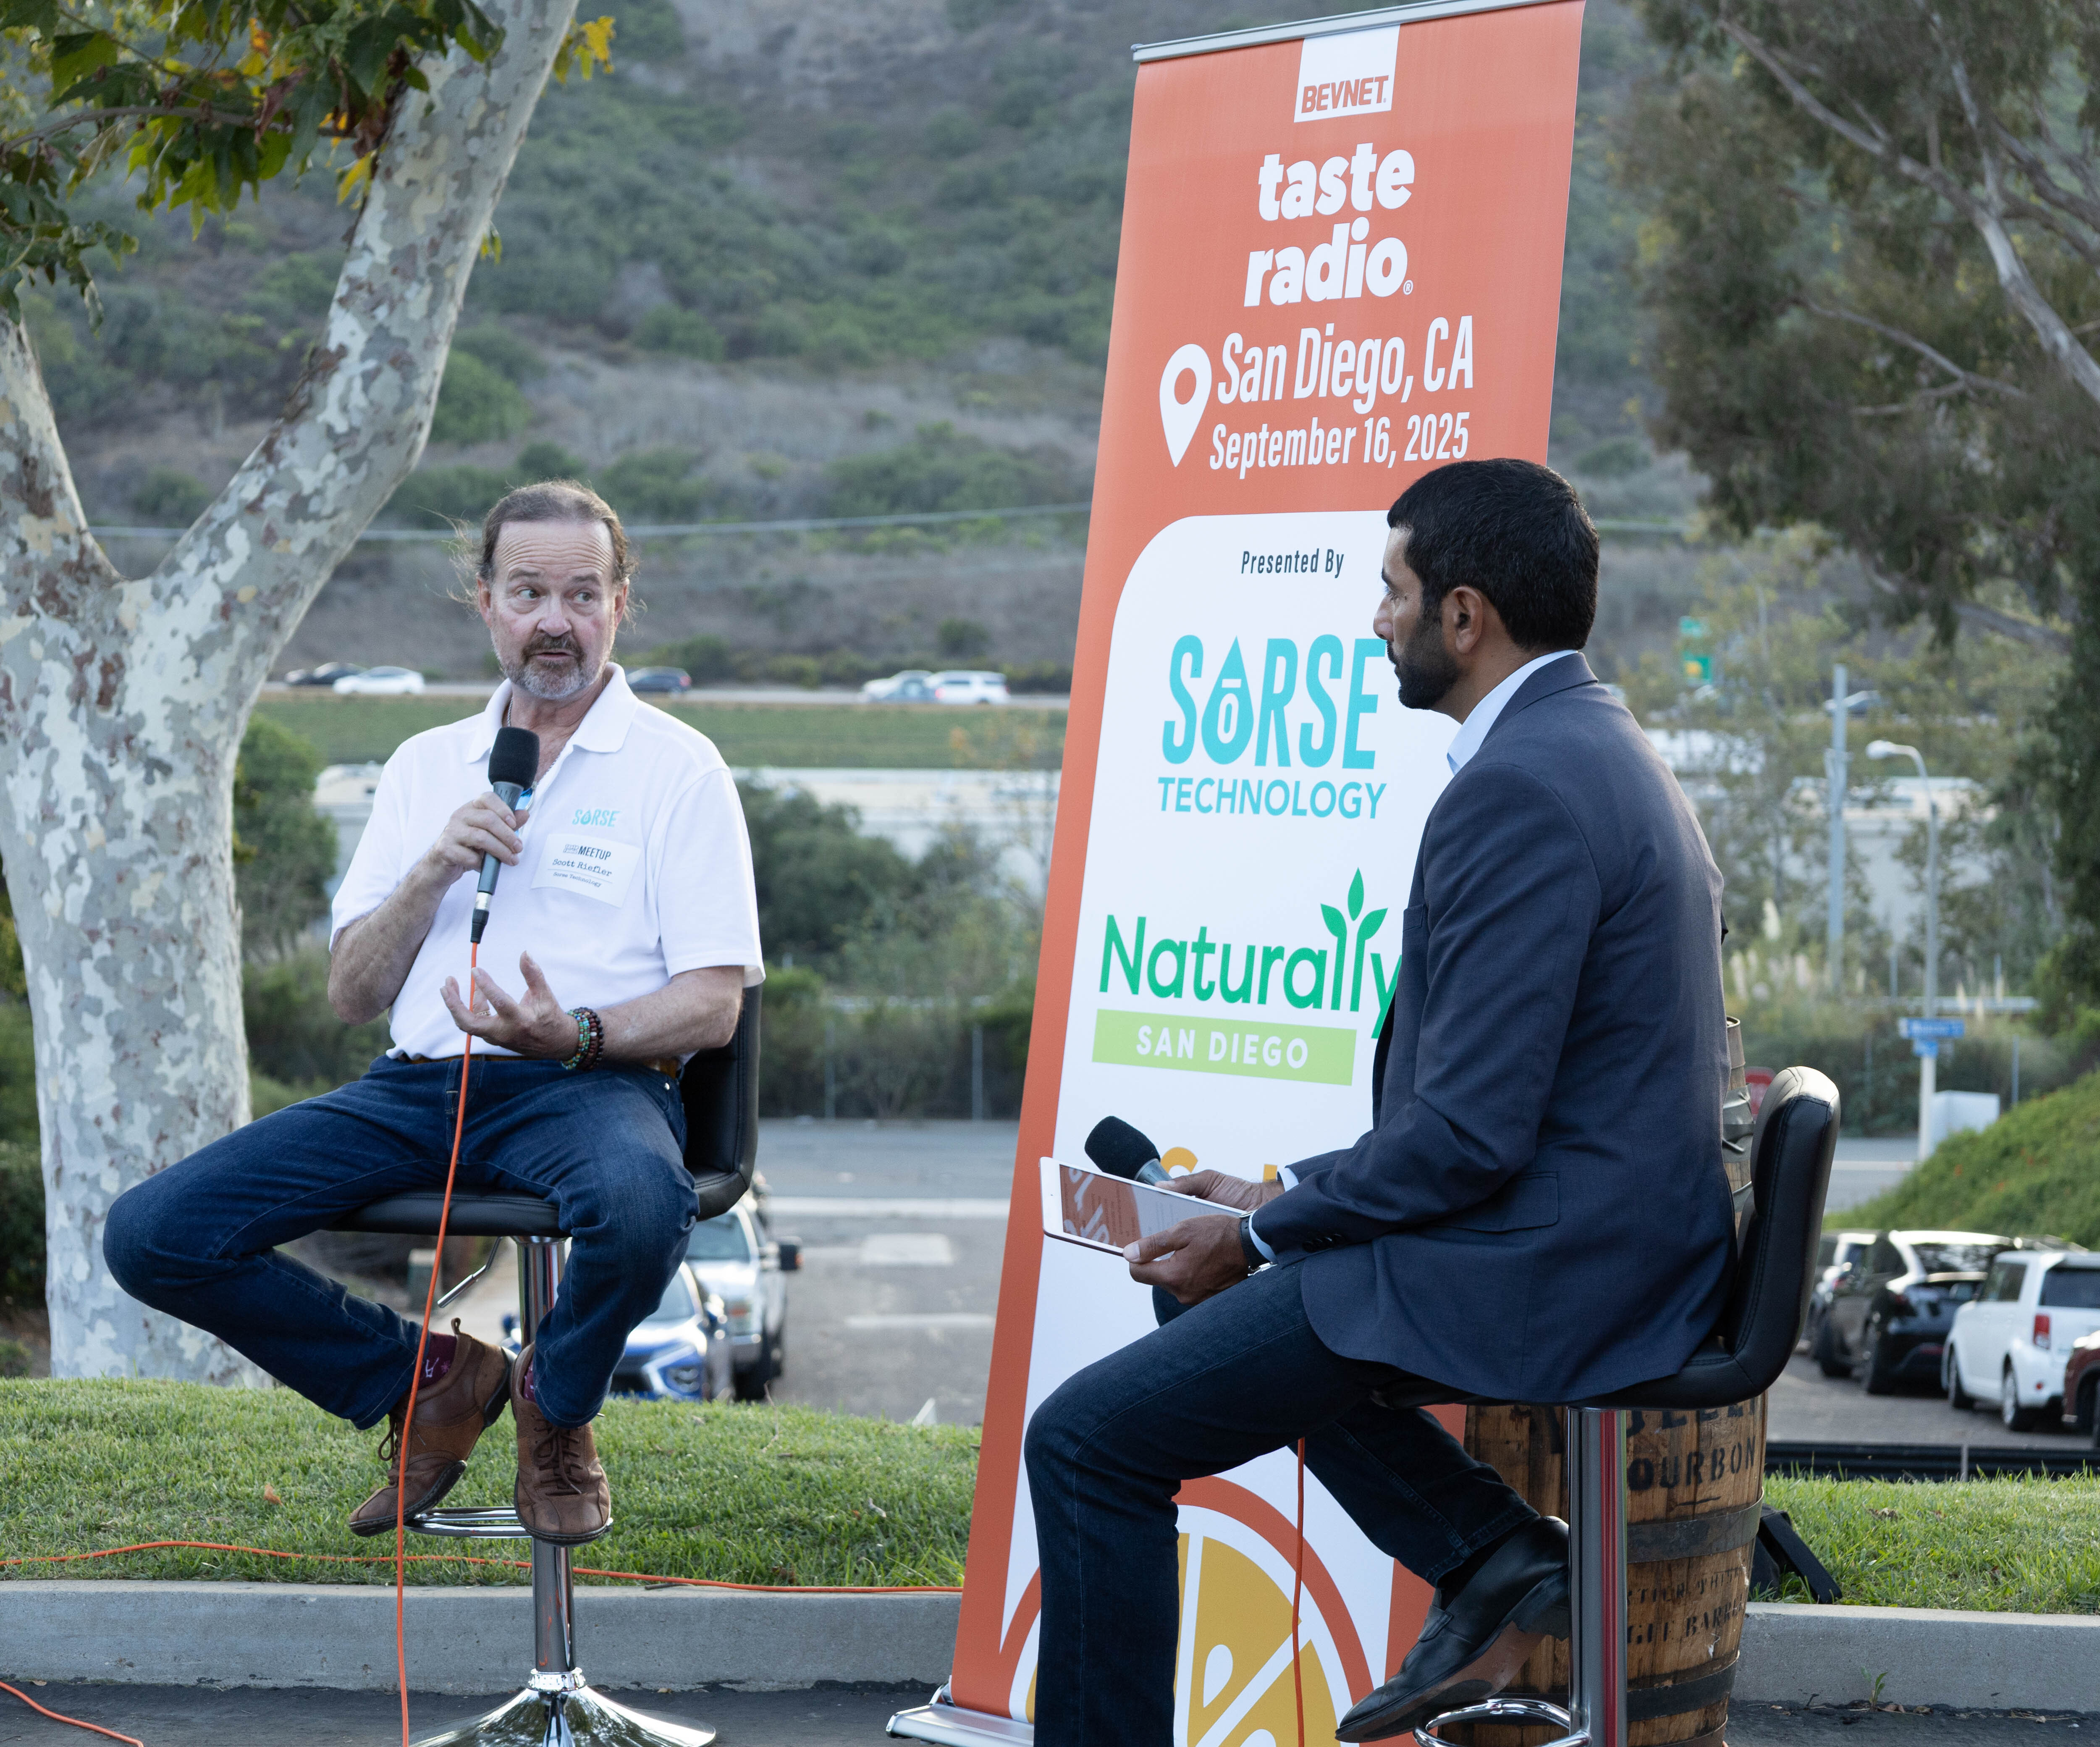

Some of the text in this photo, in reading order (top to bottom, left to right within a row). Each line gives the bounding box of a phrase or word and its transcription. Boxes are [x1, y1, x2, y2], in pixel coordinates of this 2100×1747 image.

[1258, 142, 1415, 221] taste
[1217, 315, 1473, 415] San Diego, CA
[1209, 412, 1470, 480] September 16, 2025
[1241, 548, 1344, 579] Presented By
[1158, 777, 1387, 819] TECHNOLOGY
[552, 858, 612, 876] Scott Riefler
[578, 845, 611, 860] MEETUP
[569, 874, 602, 888] Technology
[1099, 903, 1402, 1039] Naturally
[1135, 1024, 1309, 1070] SAN DIEGO
[1627, 1435, 1756, 1491] OURBON
